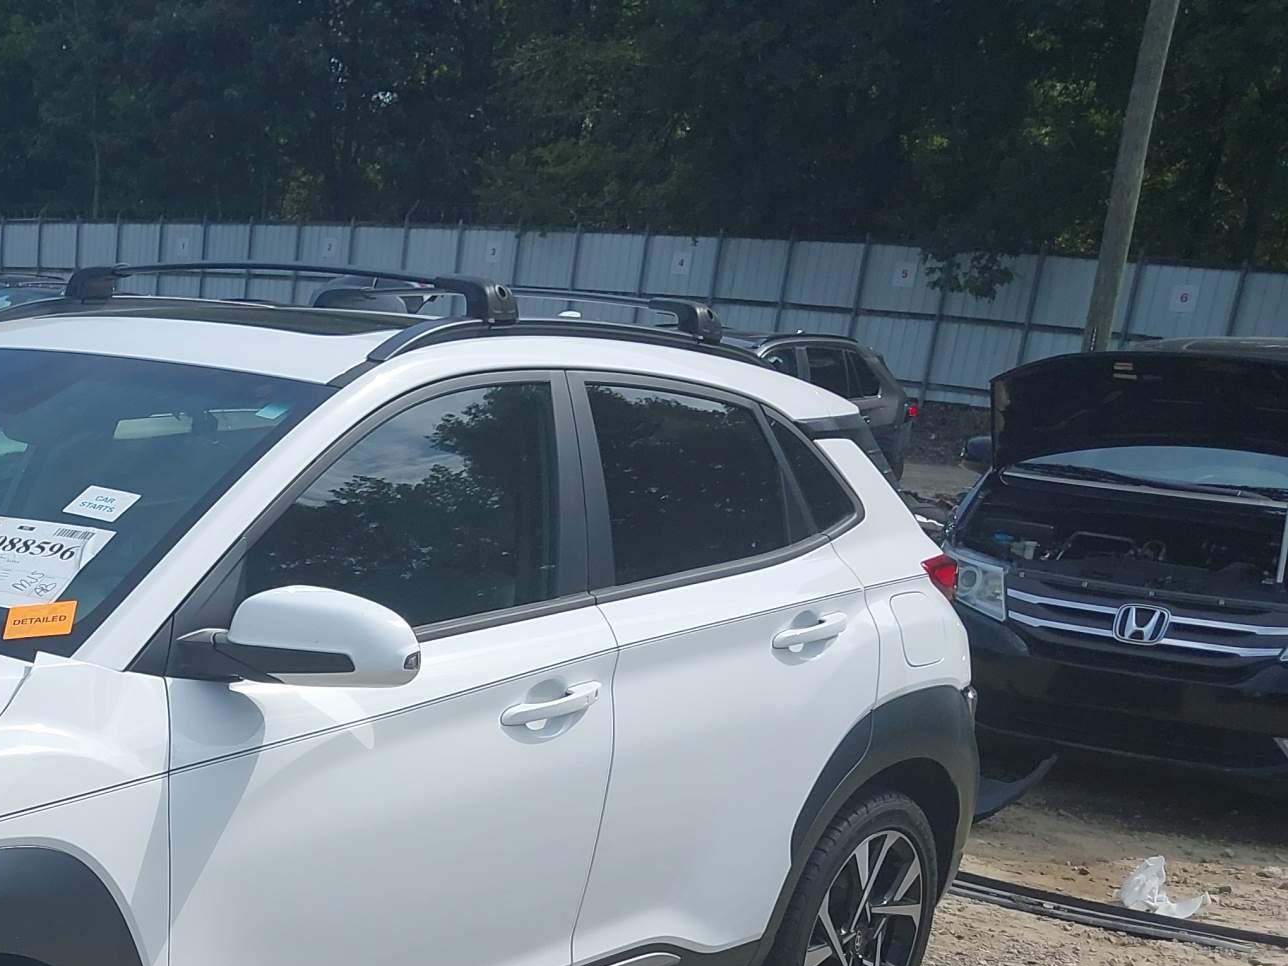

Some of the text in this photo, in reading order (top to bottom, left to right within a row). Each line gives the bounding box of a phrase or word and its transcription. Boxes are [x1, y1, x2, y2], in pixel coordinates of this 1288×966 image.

[1180, 292, 1188, 303] 6
[95, 495, 116, 504] CAR
[79, 501, 116, 513] STARTS
[12, 614, 68, 627] DETAILED
